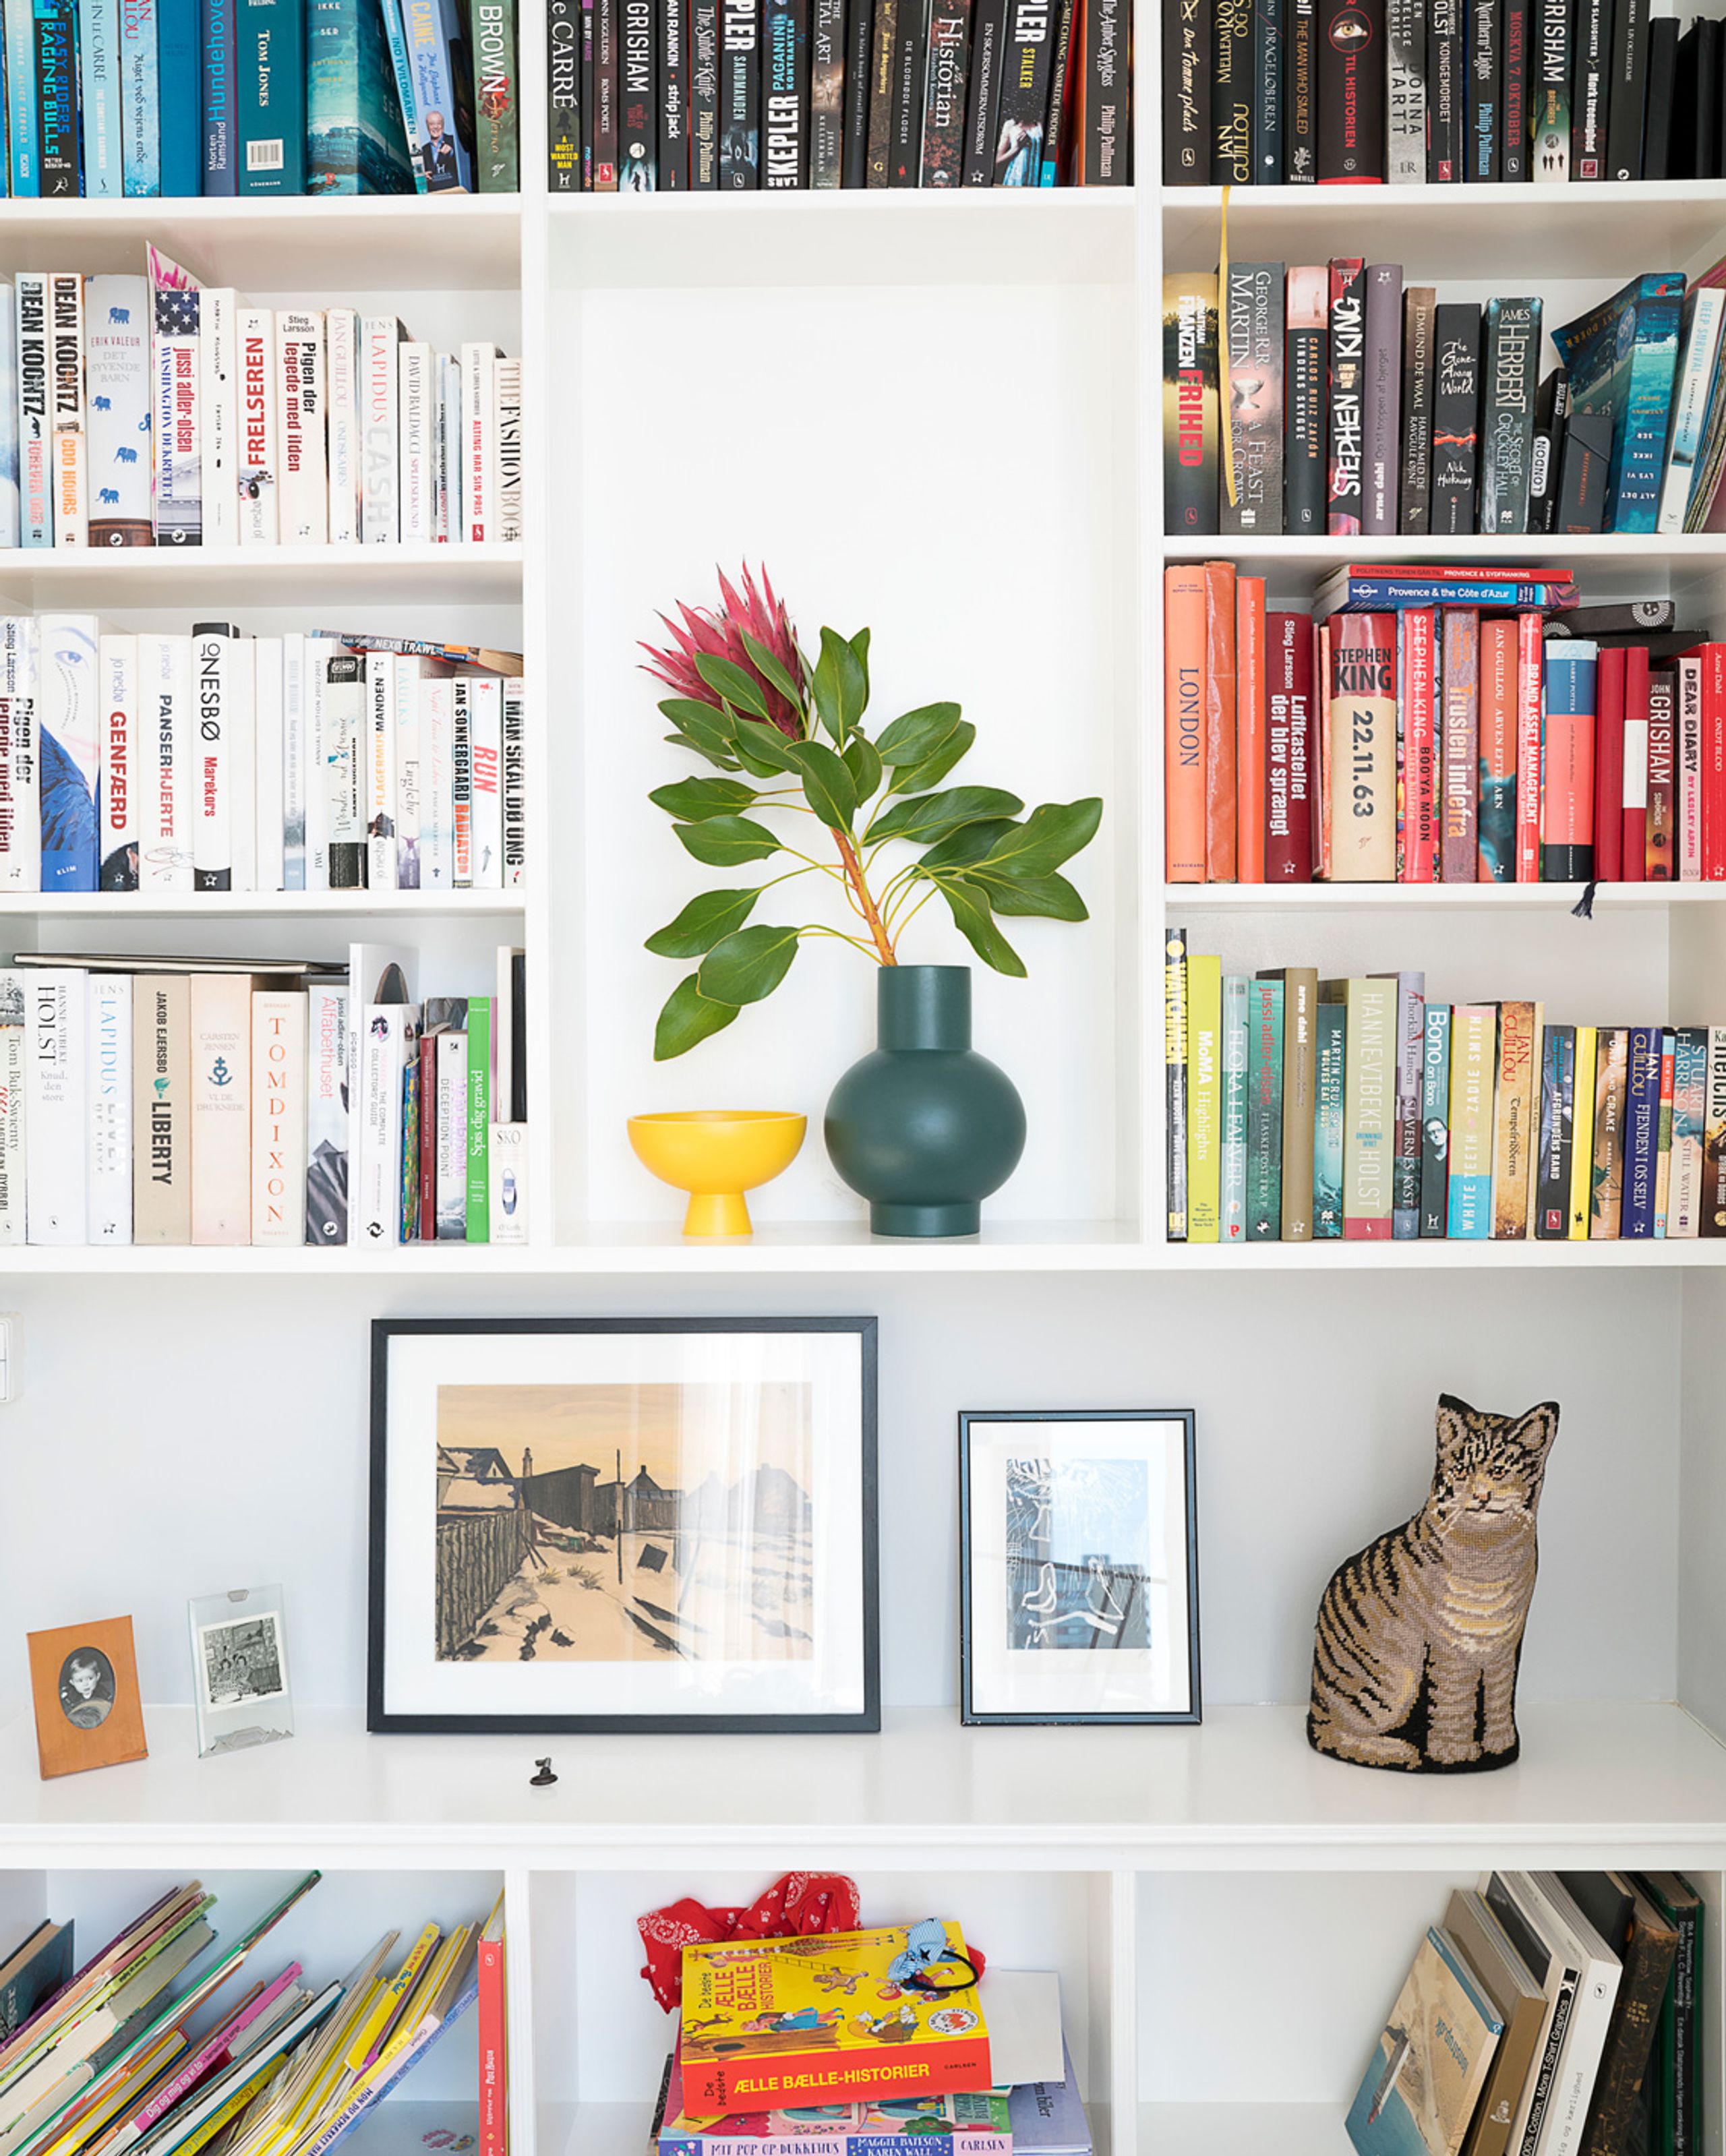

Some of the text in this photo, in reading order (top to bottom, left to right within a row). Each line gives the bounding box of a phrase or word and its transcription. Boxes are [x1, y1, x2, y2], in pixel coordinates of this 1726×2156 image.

[410, 1, 436, 49] CAINE
[479, 5, 506, 92] BROWN
[626, 3, 649, 92] GRISHAM
[667, 19, 679, 67] RANKIN
[772, 20, 786, 91] PAGANINI
[786, 20, 796, 90] KONTRAKTEN
[41, 22, 59, 156] RAGING BULLS
[53, 22, 70, 135] EASY RIDERS
[257, 30, 271, 107] TOM JONES
[551, 21, 578, 110] CARRÉ
[732, 56, 748, 121] SANDMANDEN
[934, 17, 965, 128] Historian
[1019, 47, 1037, 89] STALKER
[1264, 26, 1278, 132] DRAGELØBEREN
[1297, 20, 1309, 135] THE MAN WHO SMILED
[1345, 55, 1357, 148] TIL HISTORIEN
[1392, 63, 1407, 135] TARTT
[1408, 63, 1423, 135] DONNA
[1439, 41, 1451, 124] KONGEMORDET
[1508, 11, 1522, 147] MOSKVA 7. OKTOBER
[133, 55, 146, 164] Riget ved vejens ende
[216, 122, 227, 171] Ramsland
[665, 84, 681, 140] strip jack
[696, 111, 714, 183] Philip Pullman
[768, 95, 799, 176] KEPLER
[818, 115, 828, 173] KELLERMAN
[1097, 105, 1116, 177] Philip Pullman
[1232, 102, 1250, 182] GUILLOU
[1475, 103, 1493, 176] Philip Pullman
[54, 277, 79, 413] DEAN KOONTZ
[1178, 295, 1195, 367] FRANZEN
[1230, 272, 1254, 369] MARTIN
[1332, 296, 1362, 358] KING
[1500, 309, 1530, 320] JAMES
[300, 342, 318, 415] Pigen der
[371, 334, 388, 423] LAPIDUS
[1295, 337, 1306, 441] VINDENS SKYGGE
[1412, 305, 1427, 411] EDMUND DE WAAL
[1495, 323, 1530, 413] HERBERT
[160, 347, 173, 499] WASHINGTON DEKRETET
[173, 347, 196, 453] jussi adler-olsen
[245, 336, 266, 466] FRELSEREN
[282, 342, 303, 472] legede med ilden
[1178, 369, 1203, 467] FRIHED
[1553, 382, 1567, 415] RULED
[367, 426, 392, 523] CASH
[1247, 419, 1266, 504] A FEAST
[1332, 394, 1361, 498] STEPHEN
[1508, 436, 1524, 475] SECRET
[1533, 440, 1548, 493] LONDON
[454, 682, 469, 705] JAN
[1282, 620, 1296, 689] Stieg Larsson
[1333, 648, 1393, 663] STEPHEN
[1334, 665, 1392, 691] KING
[1412, 614, 1427, 739] STEPHEN KING
[200, 657, 222, 742] NESBØ
[1179, 667, 1200, 767] LONDON
[1649, 695, 1671, 784] GRISHAM
[110, 711, 127, 831] GENFÆRD
[159, 694, 175, 838] PANSERHJERTE
[375, 678, 387, 806] FLAGERMUSMANDEN
[473, 745, 499, 794] RUN
[1269, 694, 1289, 836] der blev sprængt
[1290, 694, 1307, 800] Luftkastellet
[1352, 709, 1374, 818] 22.11.63
[1448, 682, 1474, 838] Truslen indefra
[204, 756, 218, 817] Marekors
[400, 760, 421, 815] Engleby
[1419, 746, 1431, 843] BOO'YA MOON
[314, 849, 324, 869] IWC
[454, 804, 469, 874] RADIATOR
[37, 986, 57, 1064] HOLST
[58, 985, 67, 1065] HANNE-VIBEKE
[100, 999, 117, 1096] LAPIDUS
[156, 990, 168, 1073] JAKOB EJERSBO
[320, 996, 336, 1099] Alfabethuset
[1165, 962, 1187, 1064] WATCHMEN
[1258, 987, 1276, 1105] jussi adler-olsen
[1427, 1011, 1448, 1065] Bono
[1502, 1015, 1517, 1082] GUILLOU
[1516, 1036, 1530, 1064] JAN
[1195, 1030, 1213, 1161] MoMA Highlights
[1357, 993, 1383, 1131] HANNE-VIBEKE
[1466, 1016, 1481, 1113] ZADIE SMITH
[1631, 1034, 1647, 1096] GUILLOU
[1645, 1052, 1661, 1080] JAN
[1674, 1032, 1691, 1127] HARRISON
[1690, 1044, 1706, 1116] STUART
[151, 1101, 173, 1185] LIBERTY
[440, 1078, 450, 1178] DECEPTION POINT
[467, 1070, 487, 1156] Spis dig gravid
[496, 1129, 521, 1145] SKO
[1606, 1095, 1617, 1133] CRAKE
[1357, 1150, 1382, 1209] HOLST
[1462, 1135, 1478, 1231] WHITE TEETH
[715, 1971, 735, 2008] ÆLLE
[736, 1965, 757, 2012] BÆLLE
[758, 1962, 775, 2010] HISTORIER
[1550, 1998, 1570, 2042] Graphics
[703, 2081, 715, 2097] De
[734, 2063, 930, 2094] ÆLLE BÆLLE-HISTORIER
[943, 2062, 976, 2070] CARLSEN
[710, 2141, 839, 2156] MIT POP OP-DUKKEHUS
[857, 2135, 943, 2149] MAGGIE BATESON
[960, 2139, 1005, 2152] CARLSEN
